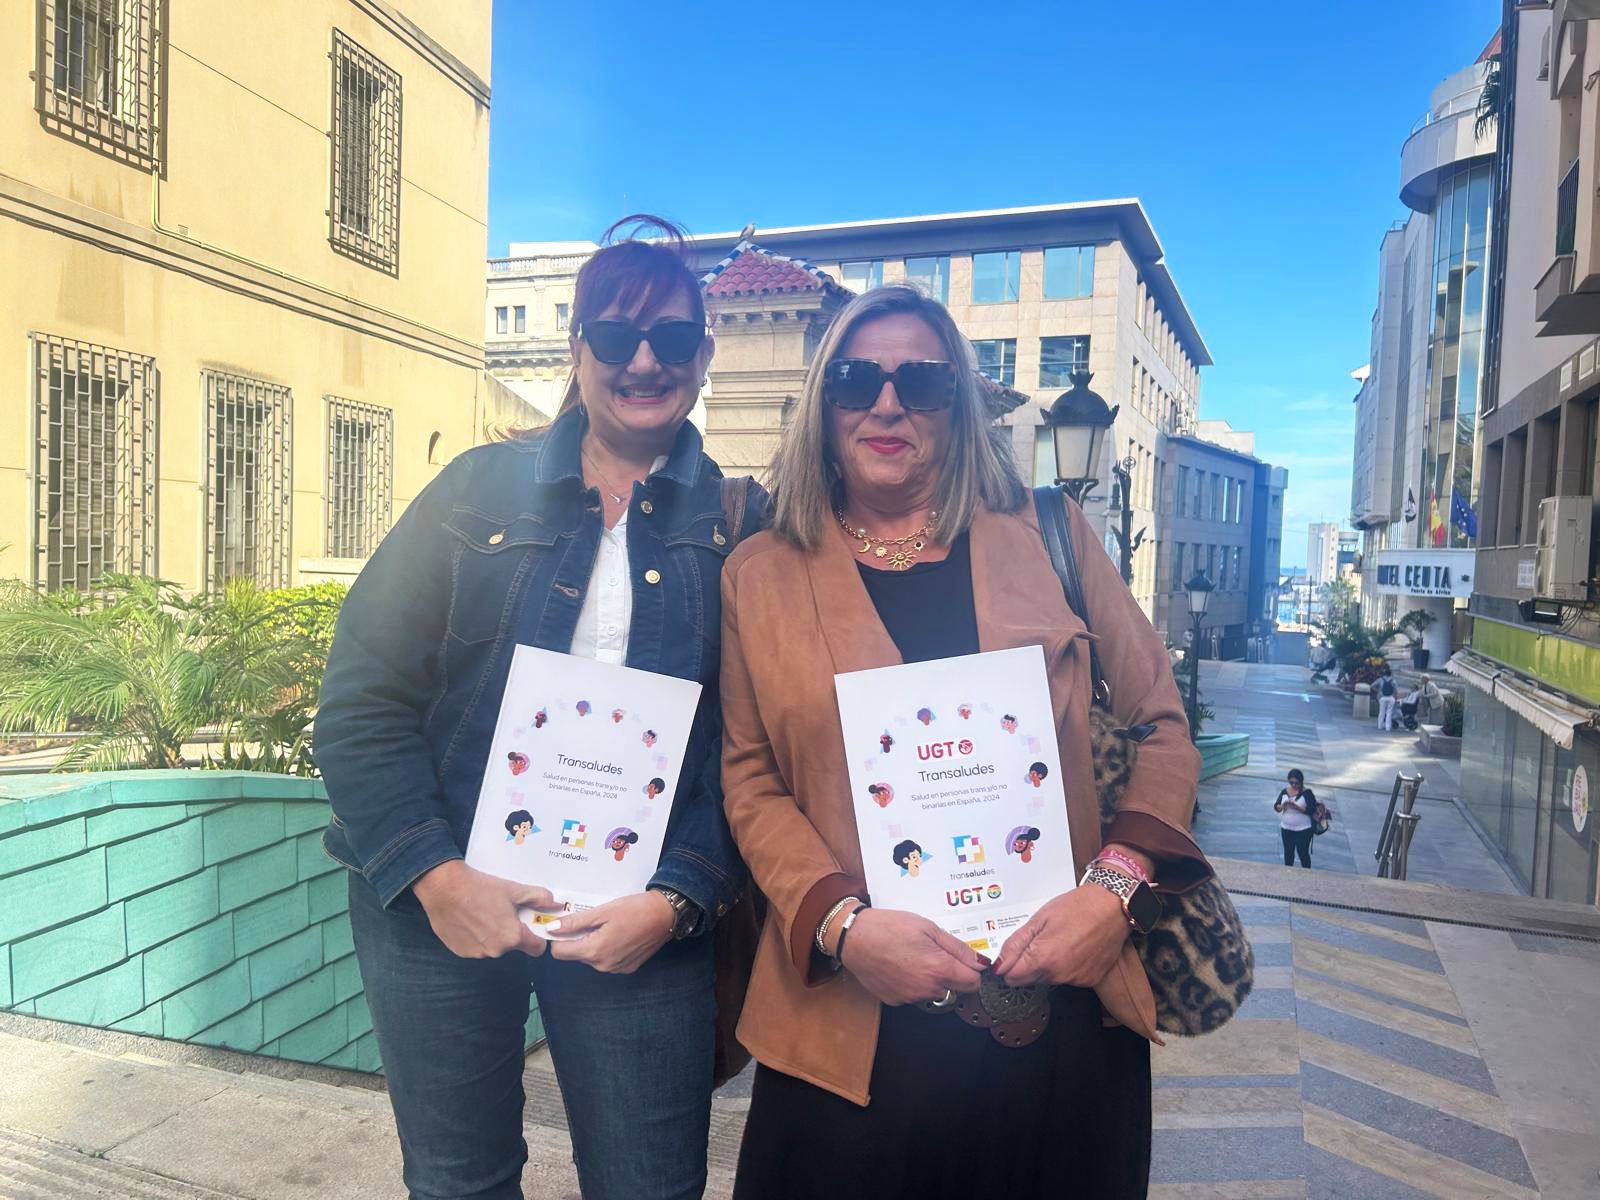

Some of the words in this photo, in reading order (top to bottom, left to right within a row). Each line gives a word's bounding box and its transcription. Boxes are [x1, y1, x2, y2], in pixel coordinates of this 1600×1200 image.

[1405, 565, 1451, 589] CEUTA
[917, 741, 955, 760] UGT
[557, 753, 623, 775] Transaludes
[917, 763, 995, 782] Transaludes
[543, 772, 560, 781] Salud
[568, 777, 595, 787] personas
[595, 781, 609, 789] trans
[609, 783, 619, 791] y/o
[549, 782, 572, 792] binarias
[602, 791, 618, 799] 2024
[911, 793, 930, 802] Salud
[939, 789, 970, 798] personas
[970, 786, 987, 794] trans
[987, 784, 998, 793] y/o
[921, 801, 947, 810] binarias
[983, 794, 1000, 802] 2024
[548, 850, 589, 862] transaludes
[950, 868, 996, 880] transaludes
[946, 886, 983, 907] UGT
